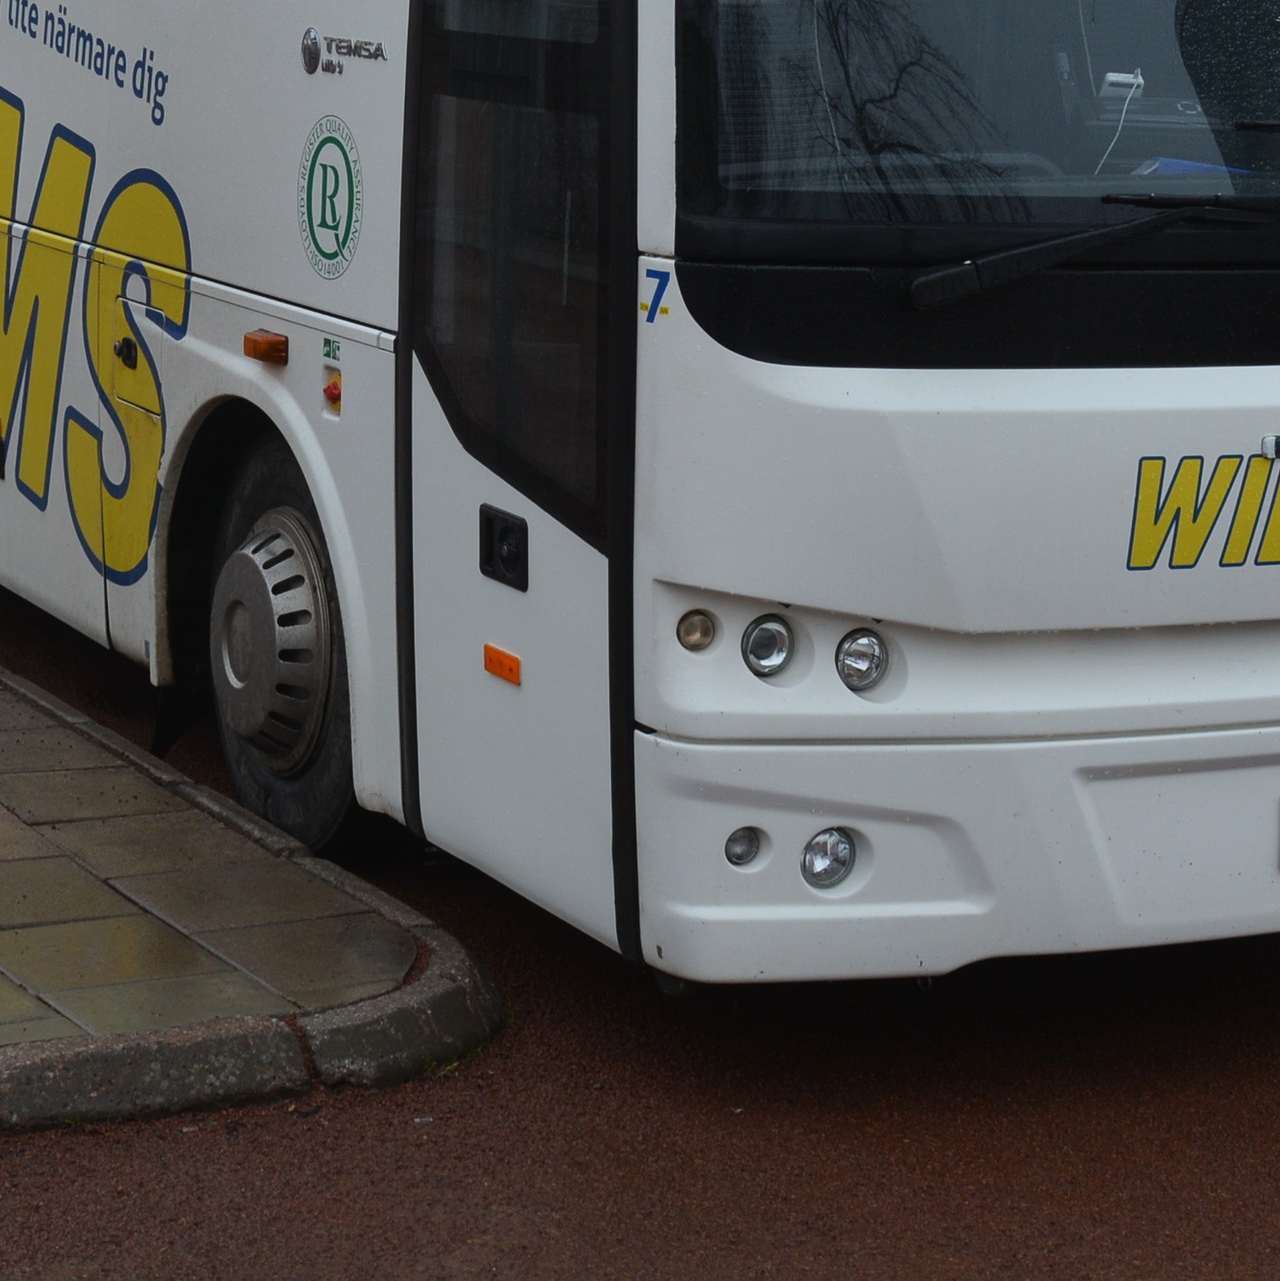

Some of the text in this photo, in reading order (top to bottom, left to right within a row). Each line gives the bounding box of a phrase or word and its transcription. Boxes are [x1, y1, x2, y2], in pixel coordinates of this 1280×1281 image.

[43, 4, 127, 88] närmare
[132, 47, 169, 126] dig
[323, 36, 388, 61] TEMSA
[299, 122, 326, 182] REGISTER
[325, 118, 356, 154] QUALITY
[346, 158, 362, 258] ASSURANCE
[645, 268, 670, 323] 7
